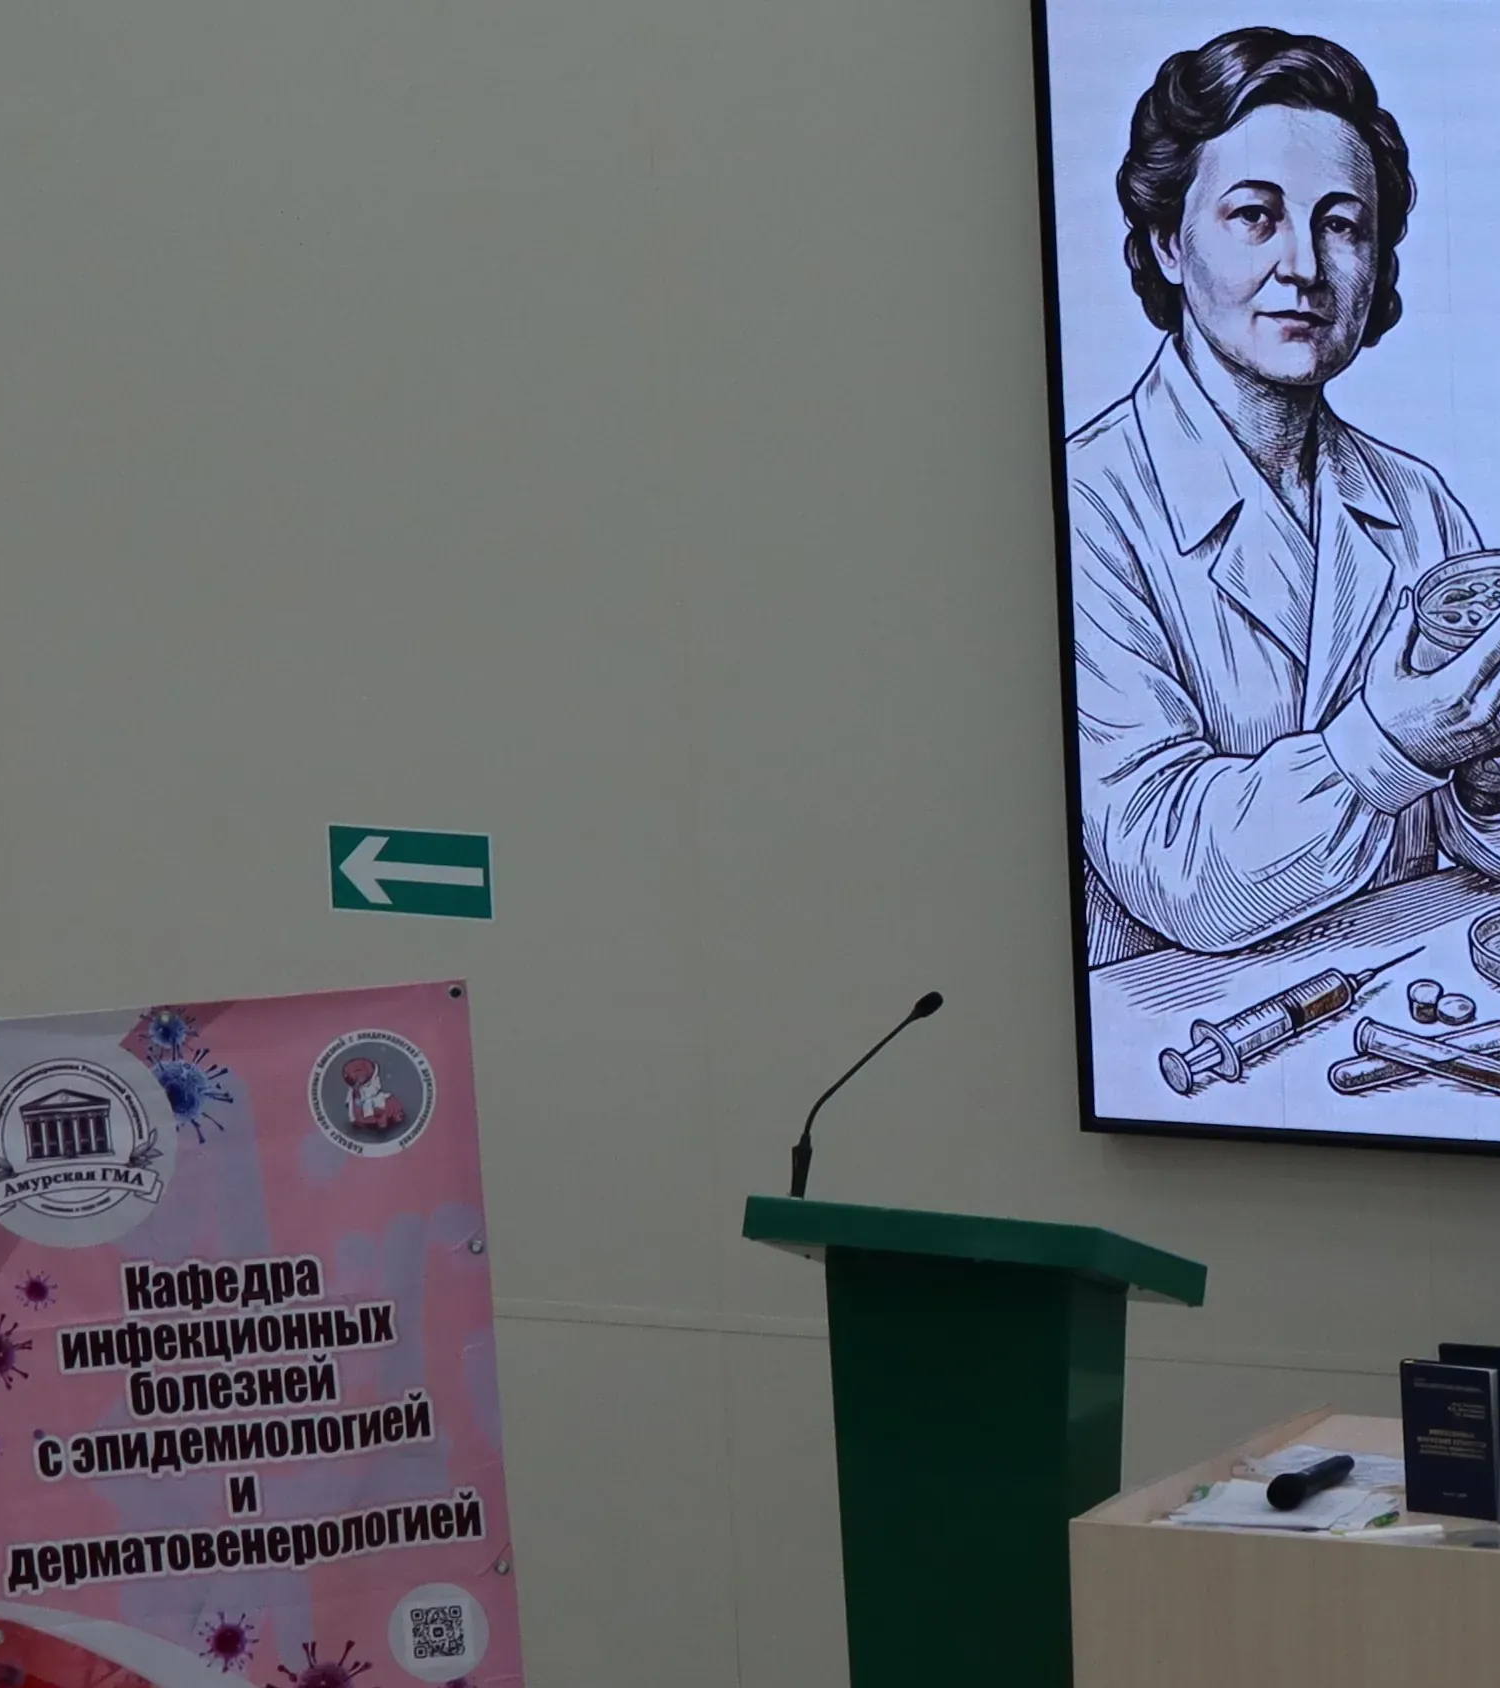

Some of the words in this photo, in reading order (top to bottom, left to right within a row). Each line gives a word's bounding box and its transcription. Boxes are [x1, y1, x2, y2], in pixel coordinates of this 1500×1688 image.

[3, 1170, 96, 1199] Амурская
[101, 1167, 144, 1187] ГМА
[124, 1259, 320, 1311] Кафедра
[61, 1305, 394, 1372] инфекционных
[130, 1353, 336, 1416] болезней
[38, 1440, 63, 1477] с
[71, 1391, 431, 1474] эпидемиологией
[229, 1476, 257, 1513] и
[8, 1491, 482, 1593] дерматовенерологией
